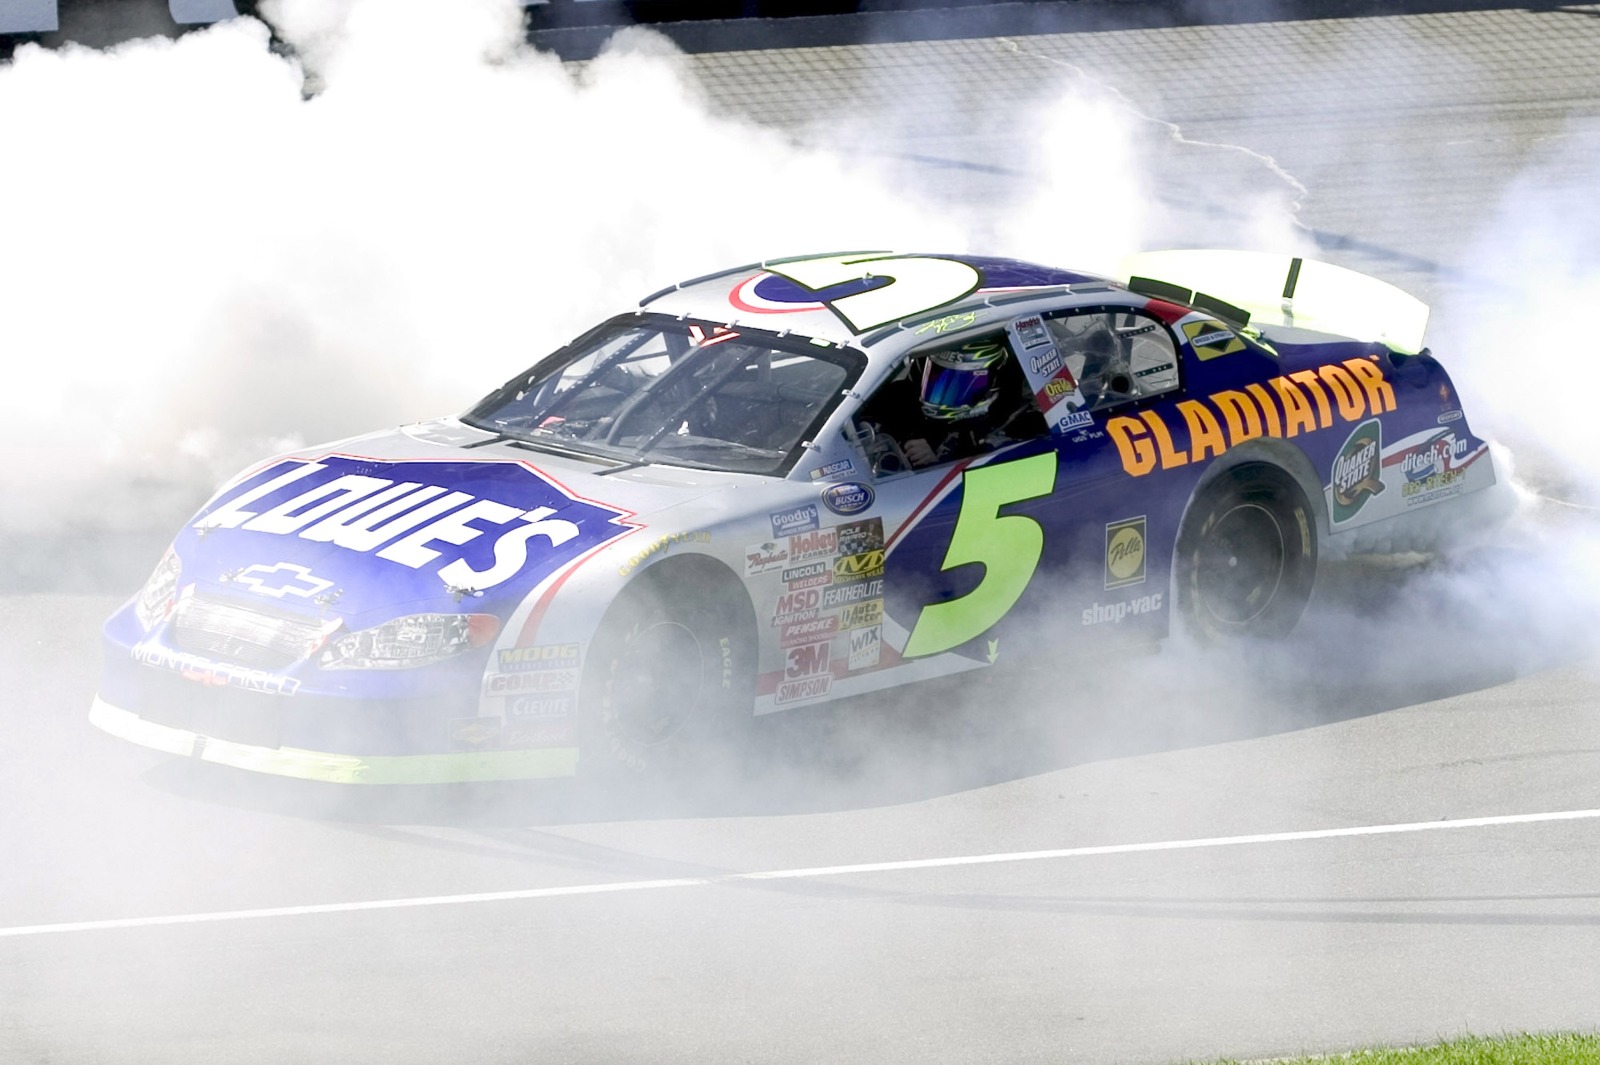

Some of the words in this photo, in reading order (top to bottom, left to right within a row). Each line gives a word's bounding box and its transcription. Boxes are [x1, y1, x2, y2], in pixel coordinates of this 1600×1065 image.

[762, 255, 986, 336] 5
[1030, 348, 1058, 373] QUAKER
[1041, 357, 1061, 378] STATE
[1060, 411, 1091, 427] GMAC
[1106, 358, 1397, 477] GLADIATOR
[823, 460, 852, 475] NASCAR
[1335, 441, 1376, 485] QUAKER
[1401, 438, 1467, 473] ditech.com
[1340, 461, 1370, 493] STATE
[835, 492, 865, 506] BUSCH
[195, 461, 581, 590] LOWE'S
[772, 507, 817, 526] Goody's
[789, 531, 837, 555] Holley
[902, 449, 1058, 658] 5
[784, 563, 824, 580] LINCOLN
[776, 589, 820, 615] MSD
[825, 581, 883, 605] FEATHERLITE
[774, 609, 816, 626] IGNITION
[852, 602, 878, 615] Auto
[786, 618, 833, 636] PENSKE
[852, 627, 879, 652] WIX
[500, 645, 578, 663] MOOG
[719, 637, 732, 689] EAGLE
[787, 644, 830, 678] 3M
[778, 678, 829, 701] SIMPSON
[512, 698, 570, 716] CLEVITE
